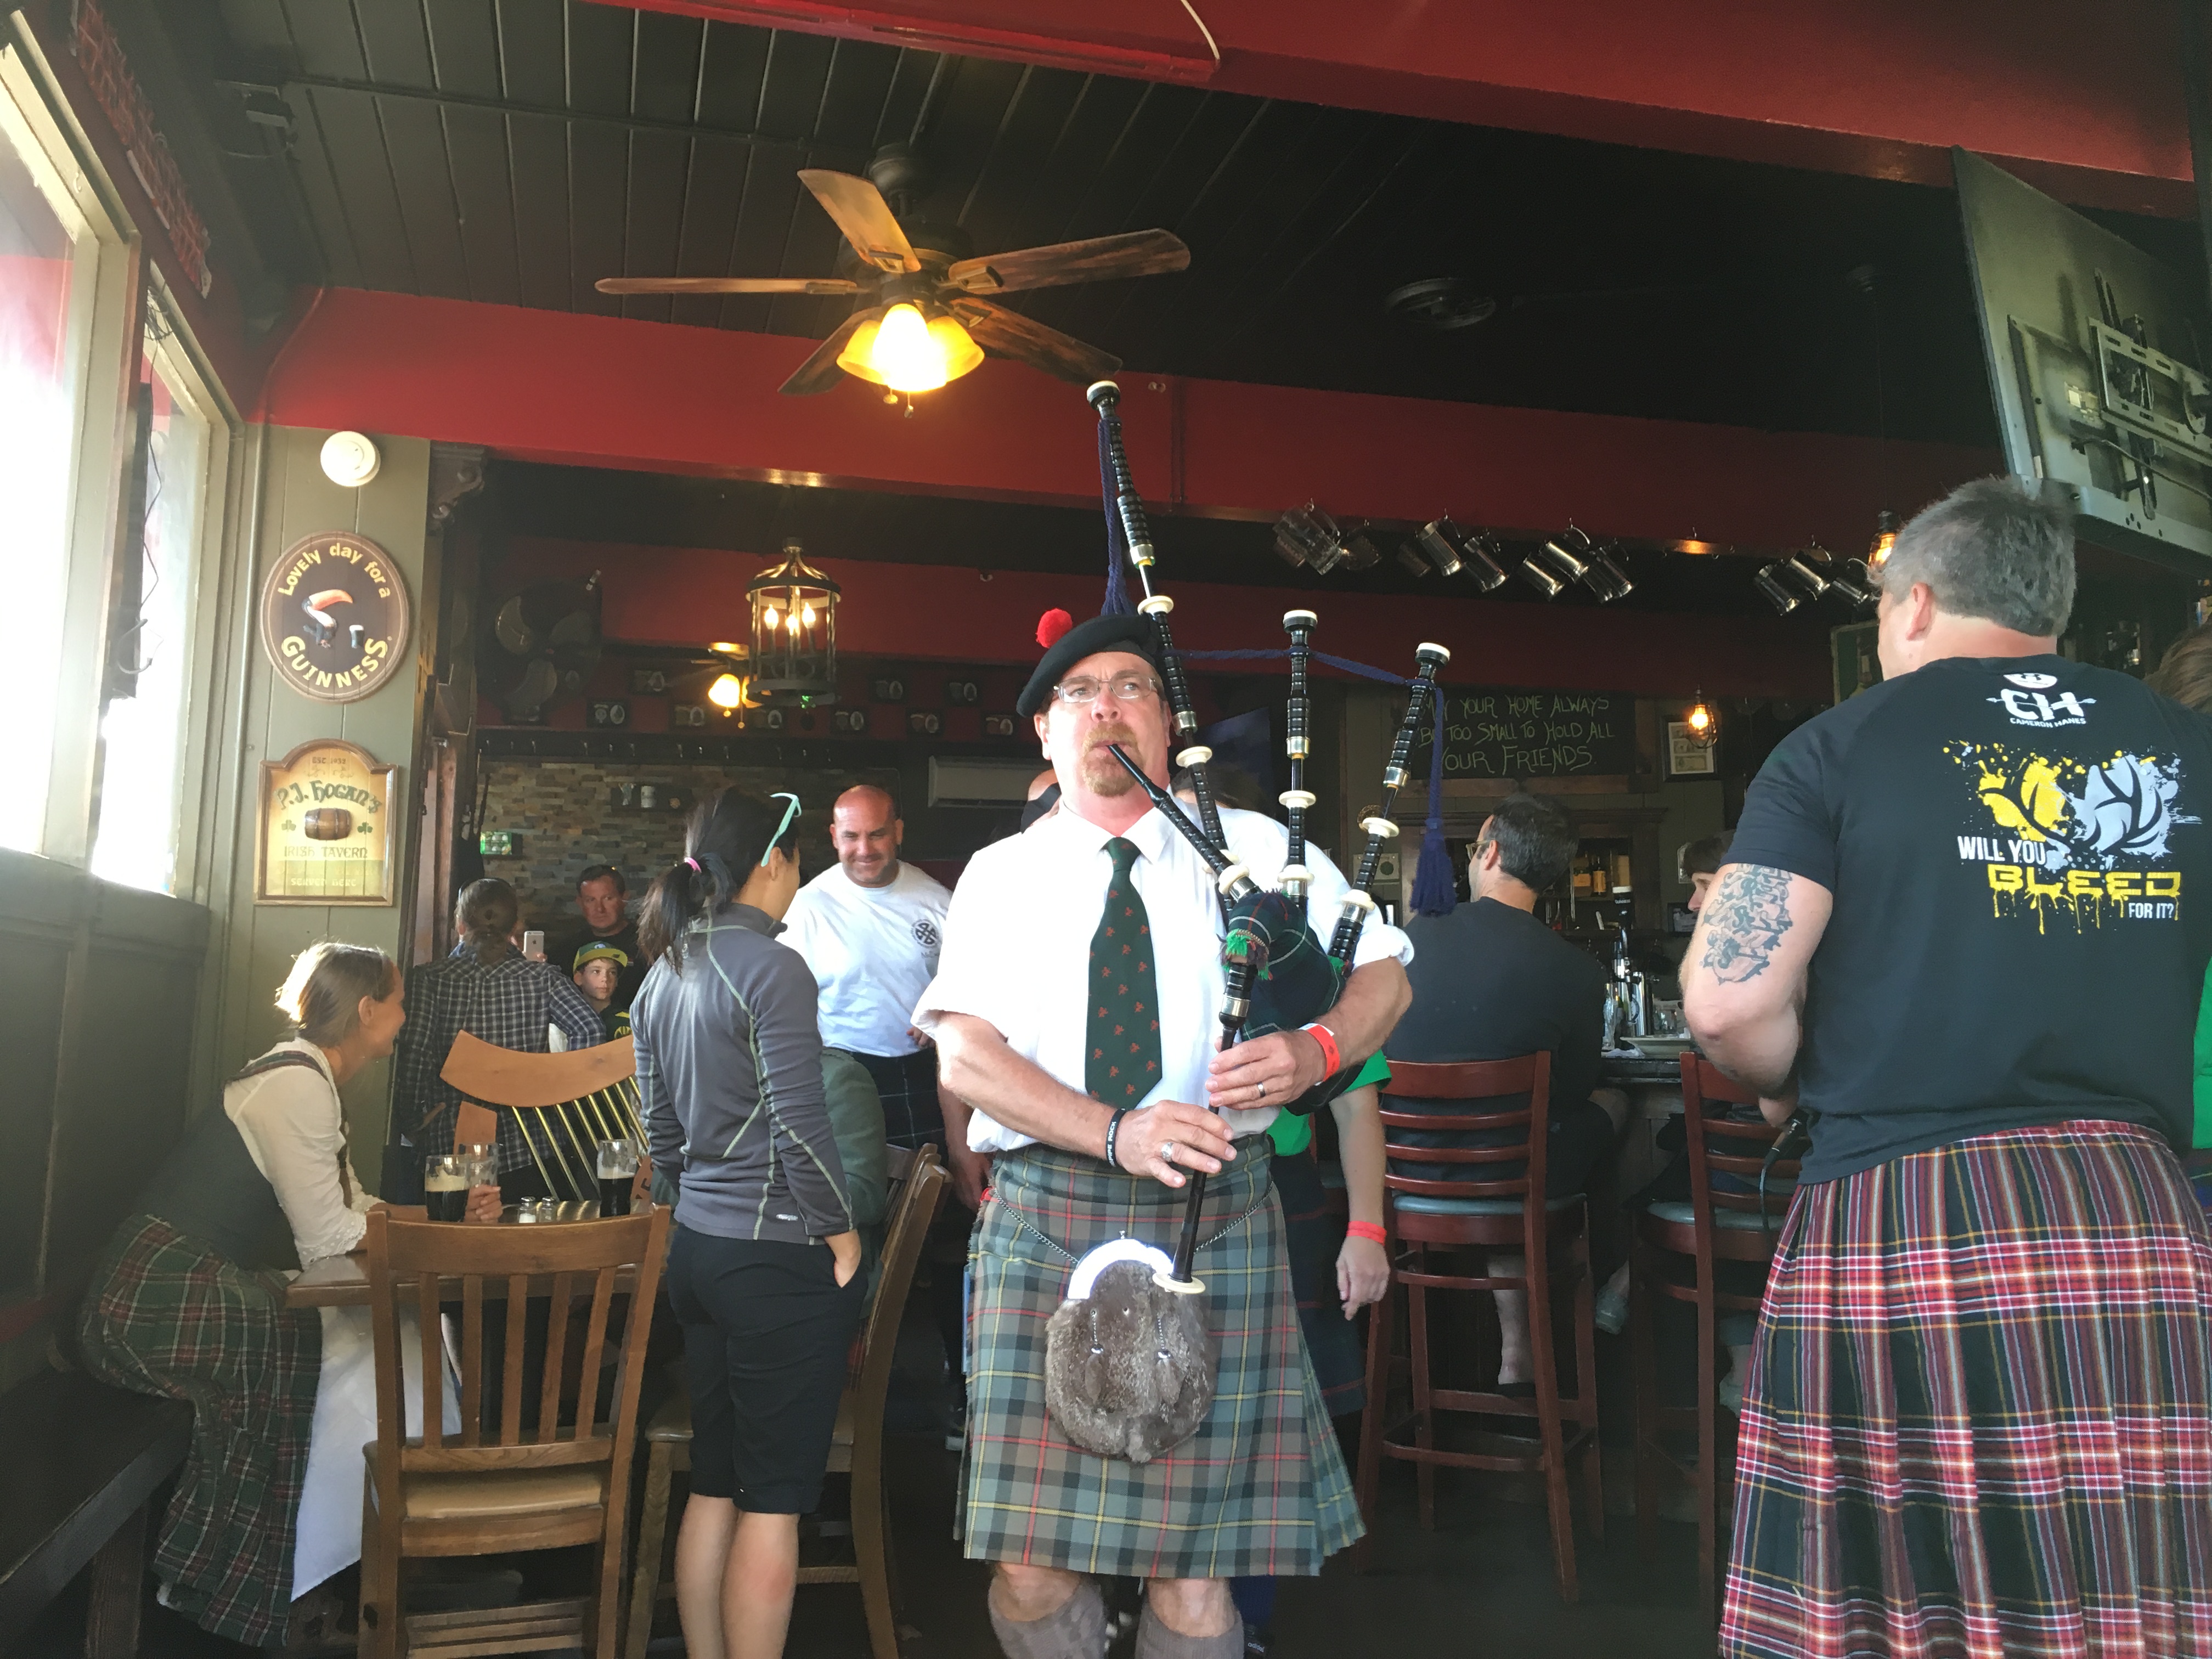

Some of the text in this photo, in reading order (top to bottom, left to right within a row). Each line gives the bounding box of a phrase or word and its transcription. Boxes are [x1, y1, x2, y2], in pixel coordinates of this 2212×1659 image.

[330, 542, 363, 565] day
[364, 561, 386, 583] for
[379, 587, 391, 598] a
[281, 636, 388, 688] GUINNESS
[1459, 696, 1498, 720] YOUR
[1505, 695, 1543, 718] HOME
[1550, 695, 1609, 718] ALWAYS
[2001, 689, 2084, 721] CH
[1446, 724, 1472, 742] TOO
[1474, 723, 1518, 746] SMALL
[1520, 720, 1536, 738] TO
[1543, 720, 1583, 745] HOLD
[1585, 721, 1616, 744] ALL
[2009, 717, 2086, 729] CAMERON HANES
[1502, 744, 1598, 776] FRIENDS.
[276, 782, 309, 810] P.J.
[284, 845, 368, 859] IRISH TAVERN
[1957, 836, 2046, 865] WILL YOU
[1987, 864, 2181, 904] BLEED
[2128, 902, 2174, 919] FOR IT?
[1108, 1121, 1117, 1142] ROCK
